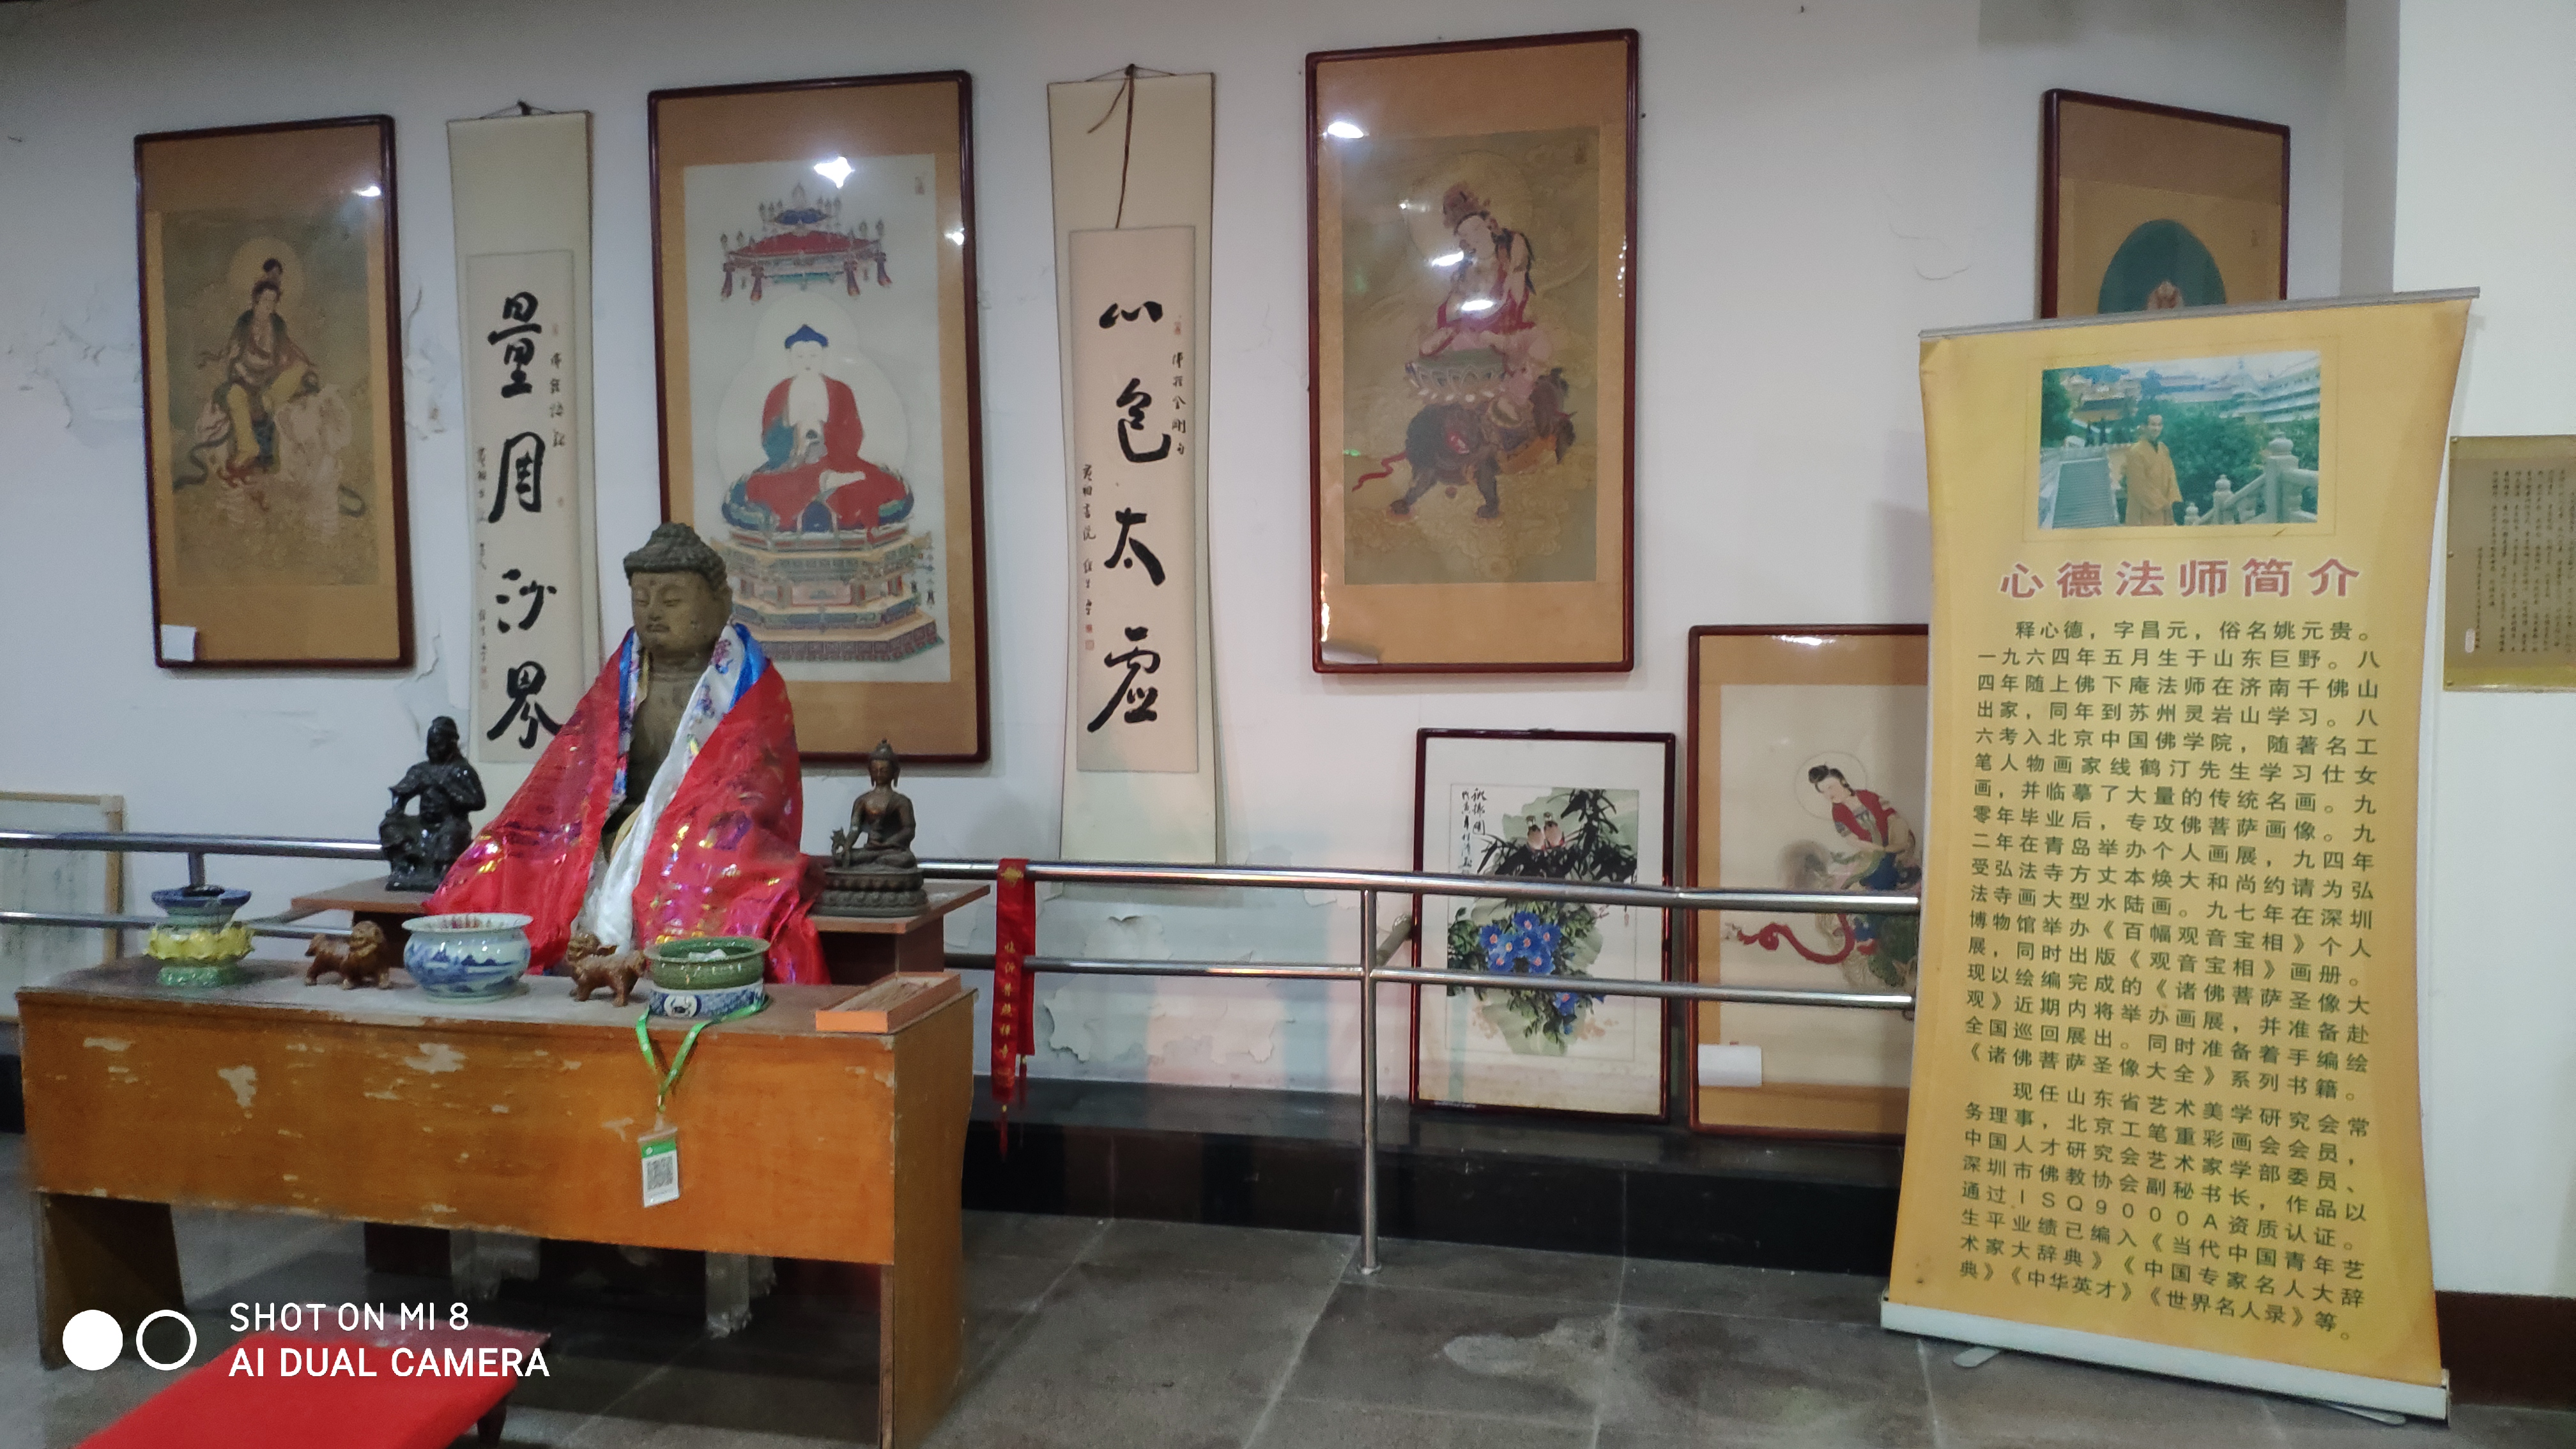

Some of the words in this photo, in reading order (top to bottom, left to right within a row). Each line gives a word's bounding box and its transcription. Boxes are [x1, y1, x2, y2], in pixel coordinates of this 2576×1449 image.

[2000, 557, 2360, 599] 心德法师简介
[2015, 620, 2368, 641] 释心德，字昌元，俗名姚元贵。
[1978, 674, 2378, 698] 四年随上佛下庵法师在济南千佛山
